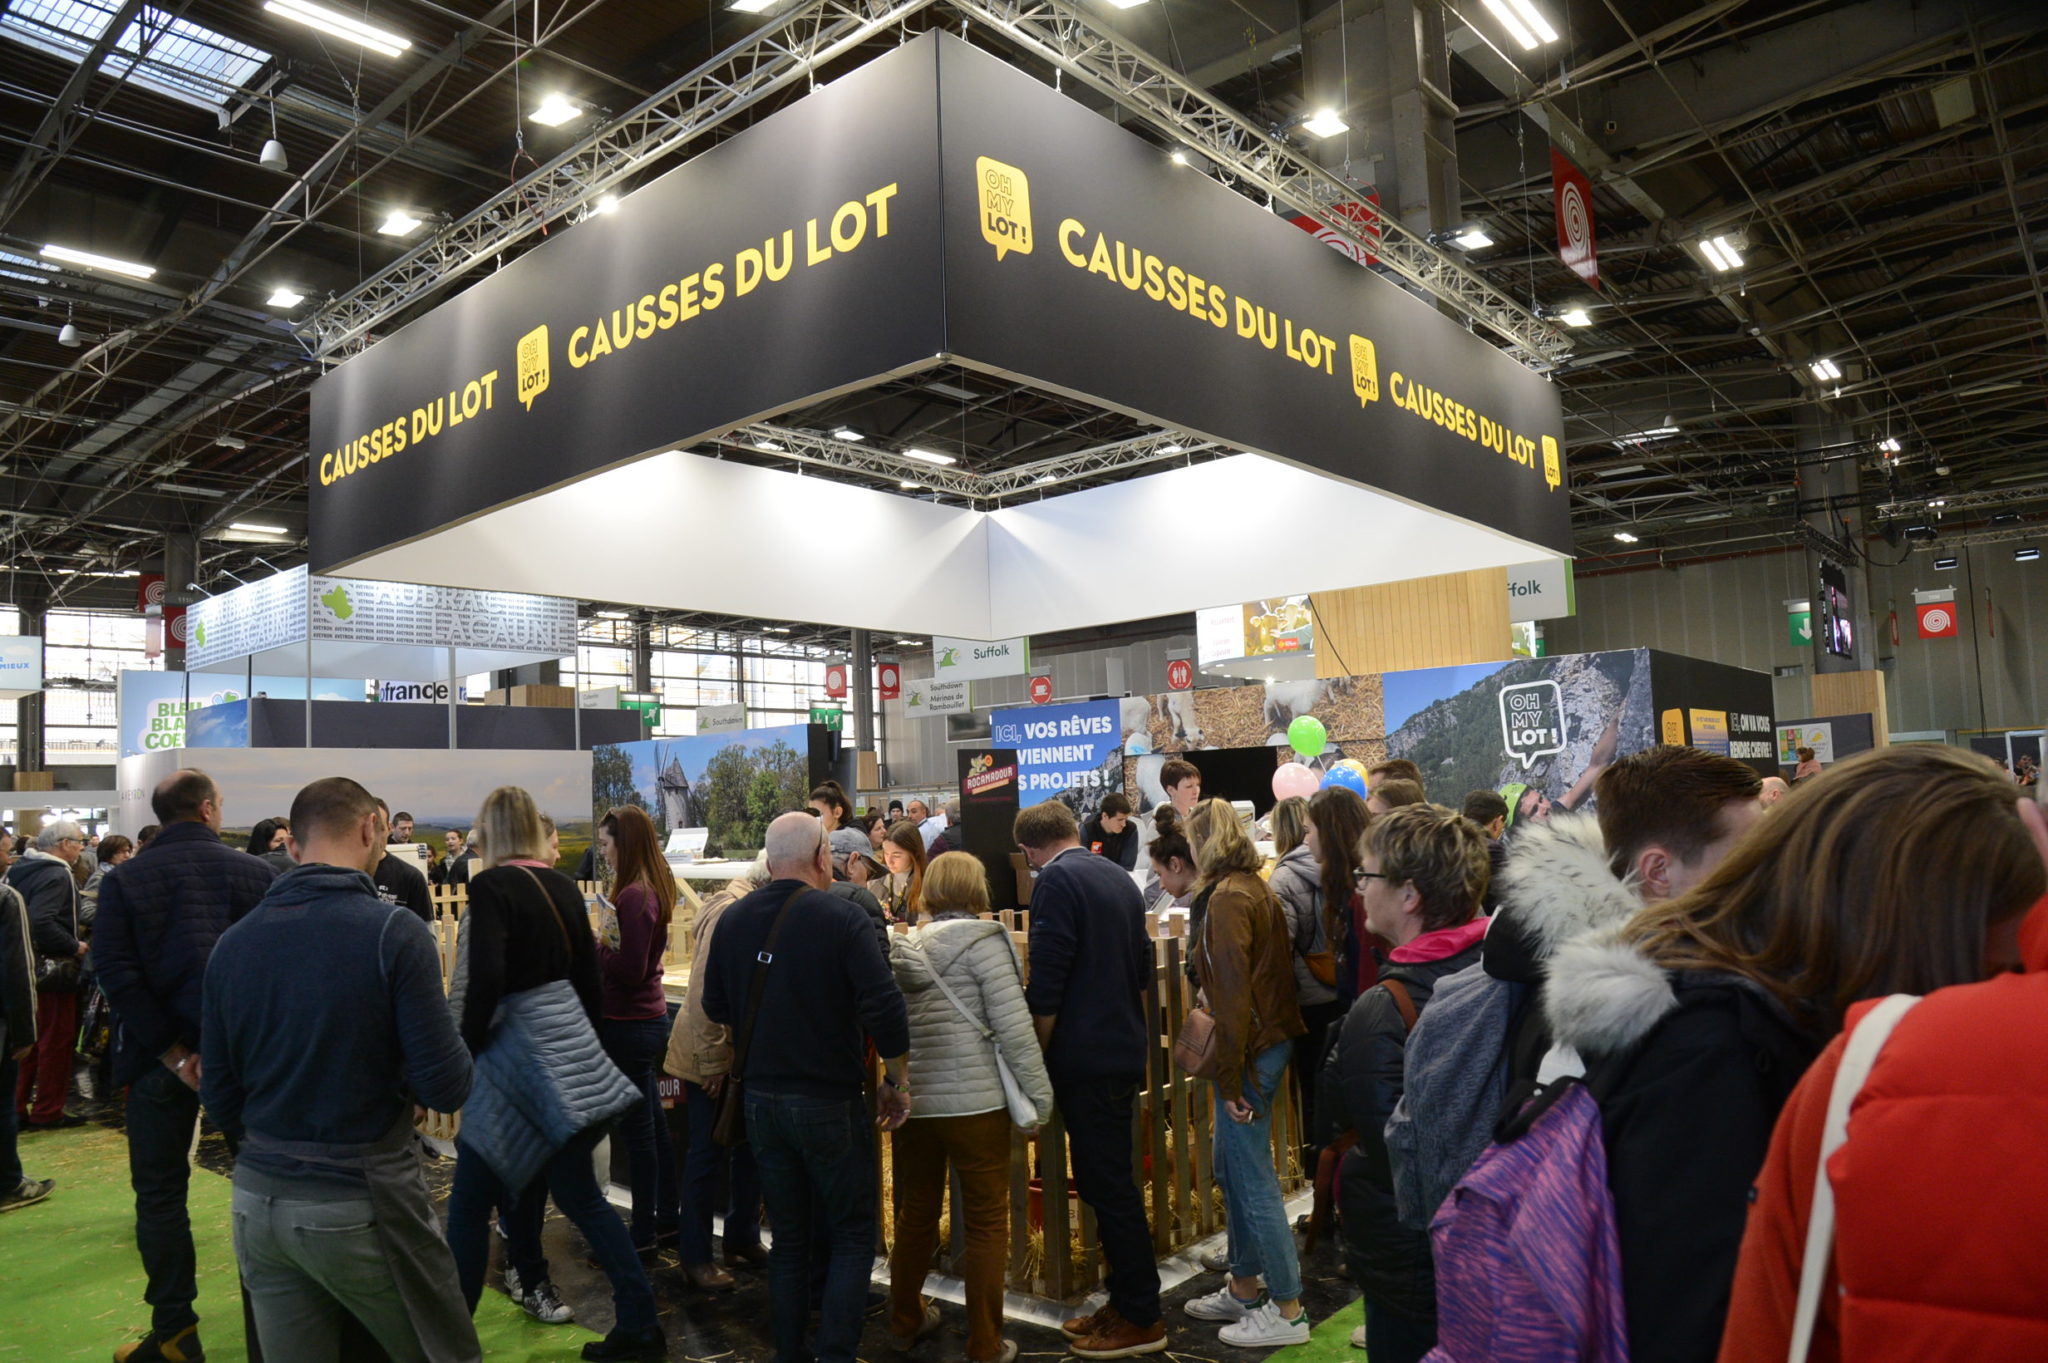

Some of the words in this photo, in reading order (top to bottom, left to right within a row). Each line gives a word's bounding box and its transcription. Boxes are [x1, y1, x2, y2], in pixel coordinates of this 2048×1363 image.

[985, 168, 1012, 196] OH
[986, 189, 1014, 218] MY
[987, 211, 1018, 241] LOT
[567, 262, 725, 369] CAUSSES
[735, 230, 794, 297] DU
[806, 182, 899, 267] LOT
[1057, 217, 1228, 329] CAUSSES
[1234, 295, 1278, 349] DU
[1284, 318, 1337, 375] LOT
[522, 371, 540, 393] LOT
[1356, 373, 1371, 392] LOT
[320, 416, 407, 486] CAUSSES
[411, 397, 443, 445] DU
[447, 369, 498, 426] LOT
[1389, 371, 1477, 441] CAUSSES
[1479, 415, 1504, 455] DU
[1506, 429, 1537, 469] LOT
[375, 583, 503, 614] AUBRAC
[431, 610, 569, 648] LACAUNE
[973, 644, 1010, 660] Suffolk
[930, 682, 963, 692] Southdown
[929, 702, 964, 711] Rambouillet
[1510, 693, 1540, 711] OH
[995, 724, 1021, 744] ICI,
[1024, 723, 1058, 739] VOS
[1060, 715, 1112, 737] RÊVES
[1511, 710, 1542, 729] MY
[145, 733, 186, 749] COE
[1512, 728, 1547, 746] LOT
[1017, 744, 1094, 766] VIENNENT
[967, 766, 1013, 790] ROCAMADOUR
[1030, 770, 1101, 790] PROJETS
[657, 1078, 681, 1097] OUR
